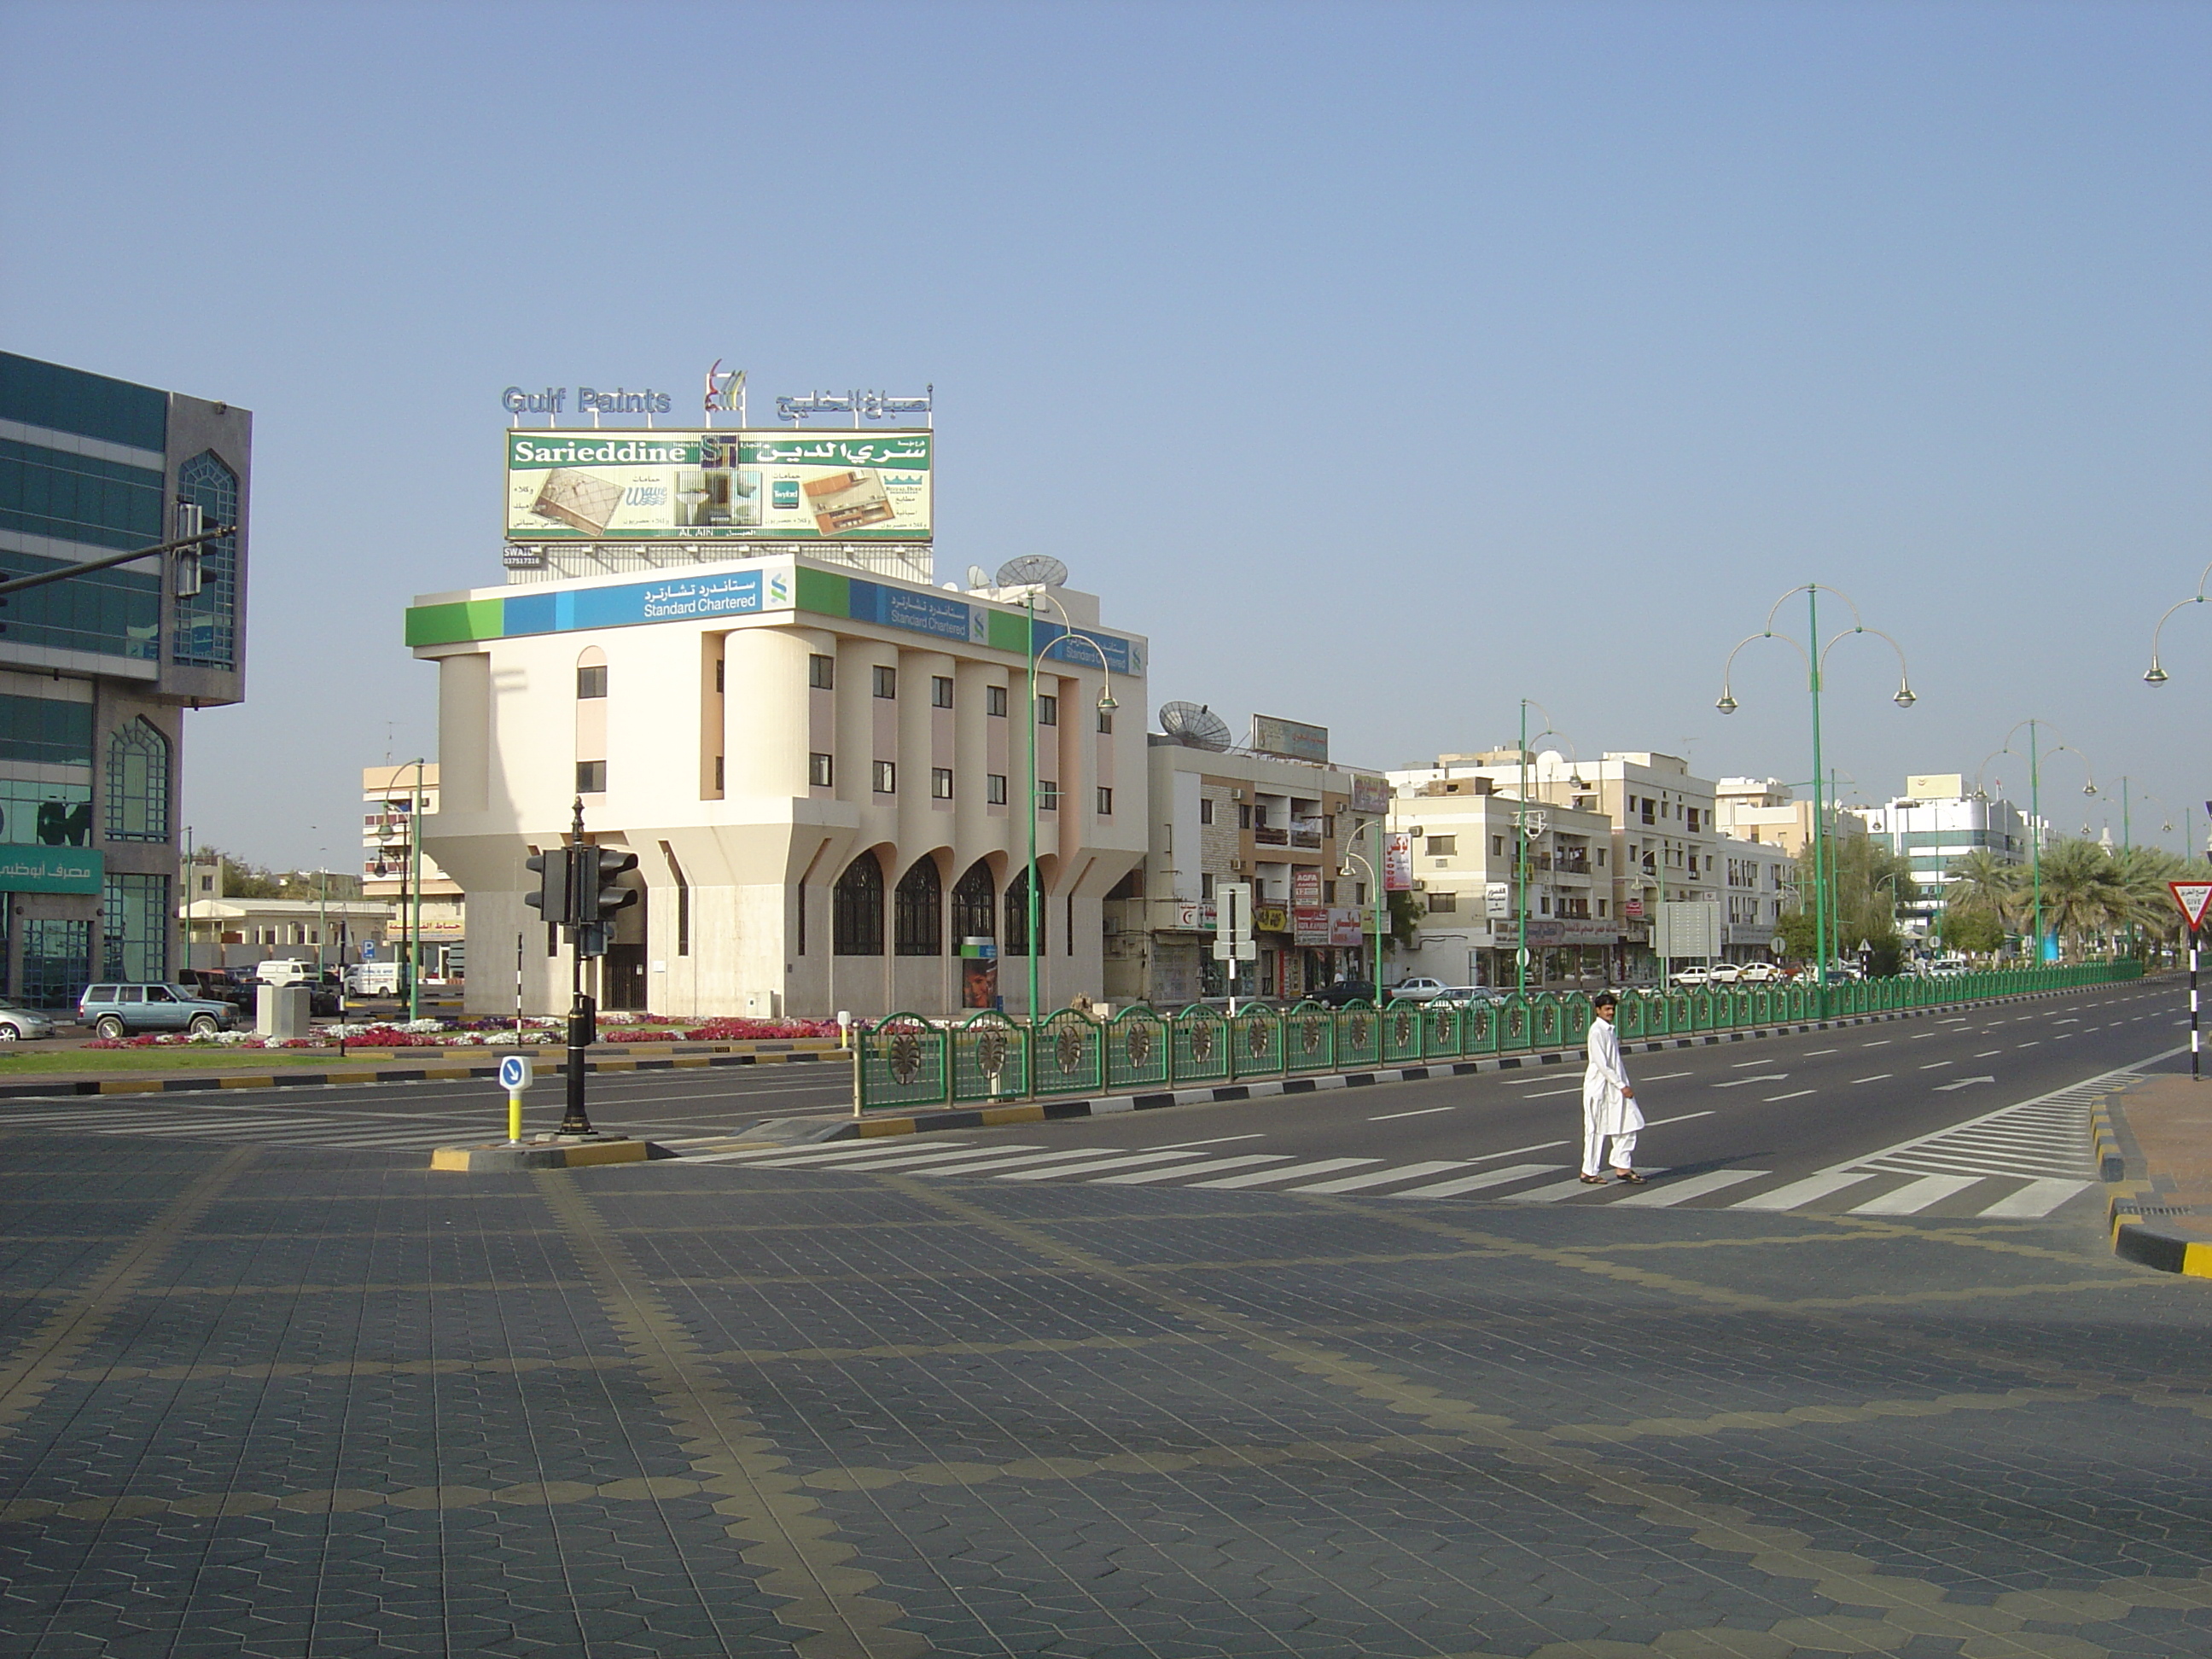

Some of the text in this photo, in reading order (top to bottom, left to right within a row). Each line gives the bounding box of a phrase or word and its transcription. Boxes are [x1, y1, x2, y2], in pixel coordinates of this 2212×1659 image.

[502, 387, 672, 413] Gulf Paints
[776, 383, 933, 421] أصباغ الخليج
[515, 441, 686, 462] Sarieddine
[757, 442, 847, 463] الدين
[644, 594, 756, 617] Standard Chartered
[891, 609, 965, 636] Standard Chartered
[48, 863, 90, 879] مصرف
[364, 941, 374, 953] P
